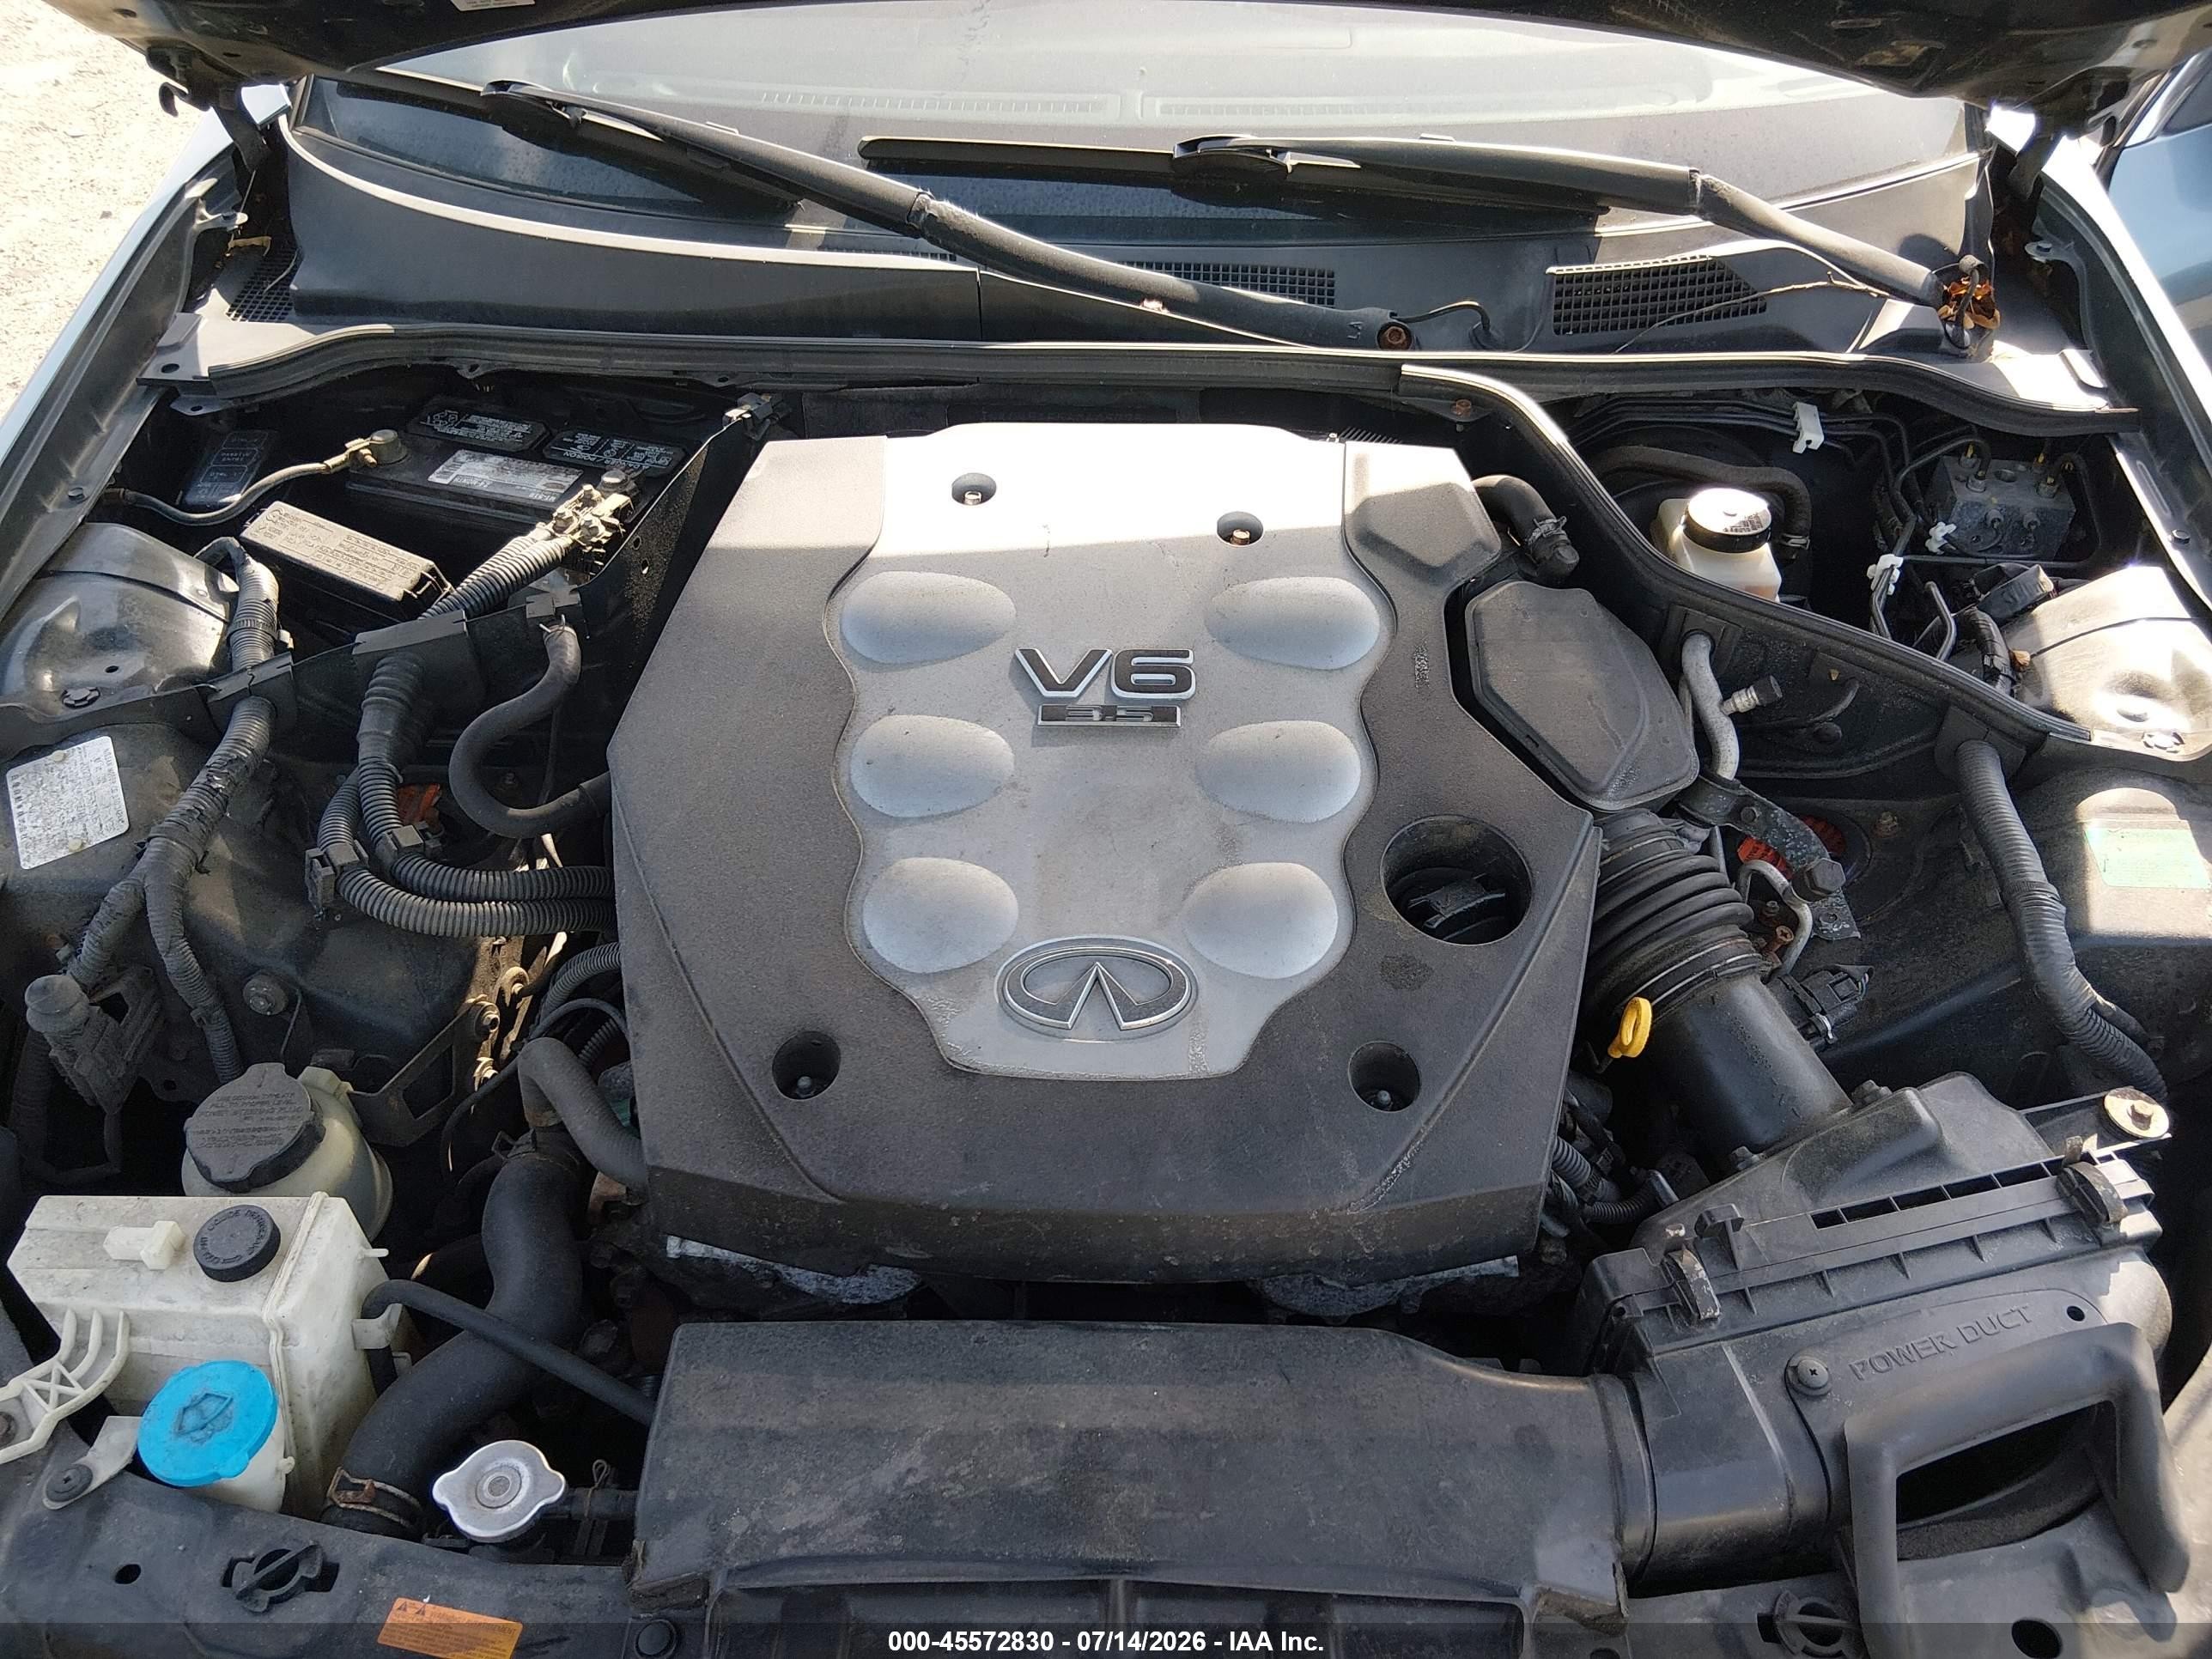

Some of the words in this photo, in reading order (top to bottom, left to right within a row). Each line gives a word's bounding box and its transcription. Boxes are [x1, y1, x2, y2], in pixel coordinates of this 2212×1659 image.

[1014, 647, 1197, 701] V6
[1848, 1333, 1959, 1382] POWER
[1956, 1304, 2033, 1345] DUCT
